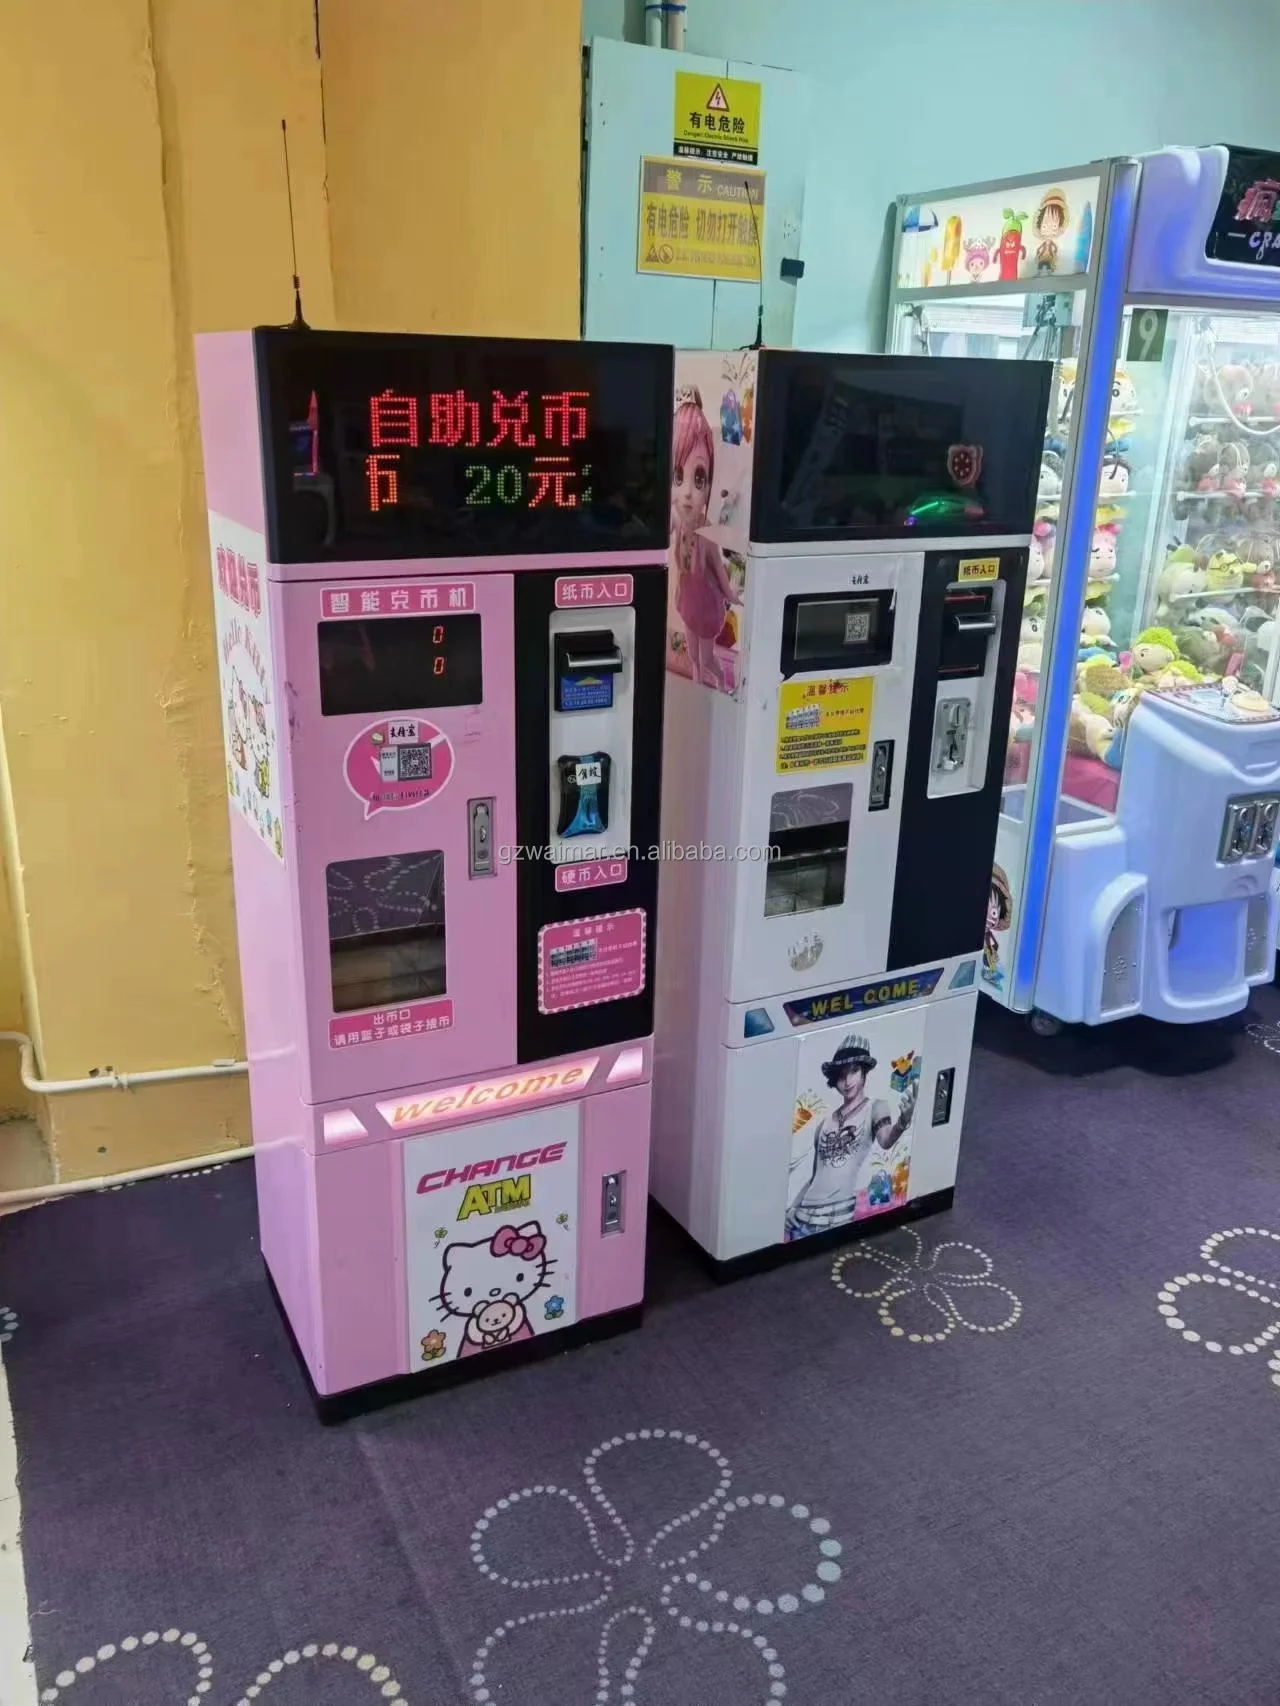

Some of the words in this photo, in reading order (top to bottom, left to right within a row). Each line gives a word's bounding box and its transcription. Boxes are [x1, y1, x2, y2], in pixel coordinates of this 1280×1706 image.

[689, 111, 746, 134] 有电危险
[646, 200, 690, 240] 有电危险
[1139, 310, 1158, 360] 9
[368, 388, 590, 448] 自助兑币
[963, 564, 996, 576] 纸币入口
[330, 587, 468, 614] 智能兑币机
[562, 582, 628, 601] 纸币入口
[432, 625, 444, 644] 0
[433, 656, 445, 675] 0
[561, 864, 622, 885] 硬币入口
[373, 1009, 411, 1026] 出币口
[393, 1066, 584, 1123] welcome
[416, 1141, 568, 1195] CHANGE
[456, 1173, 532, 1222] ATM
